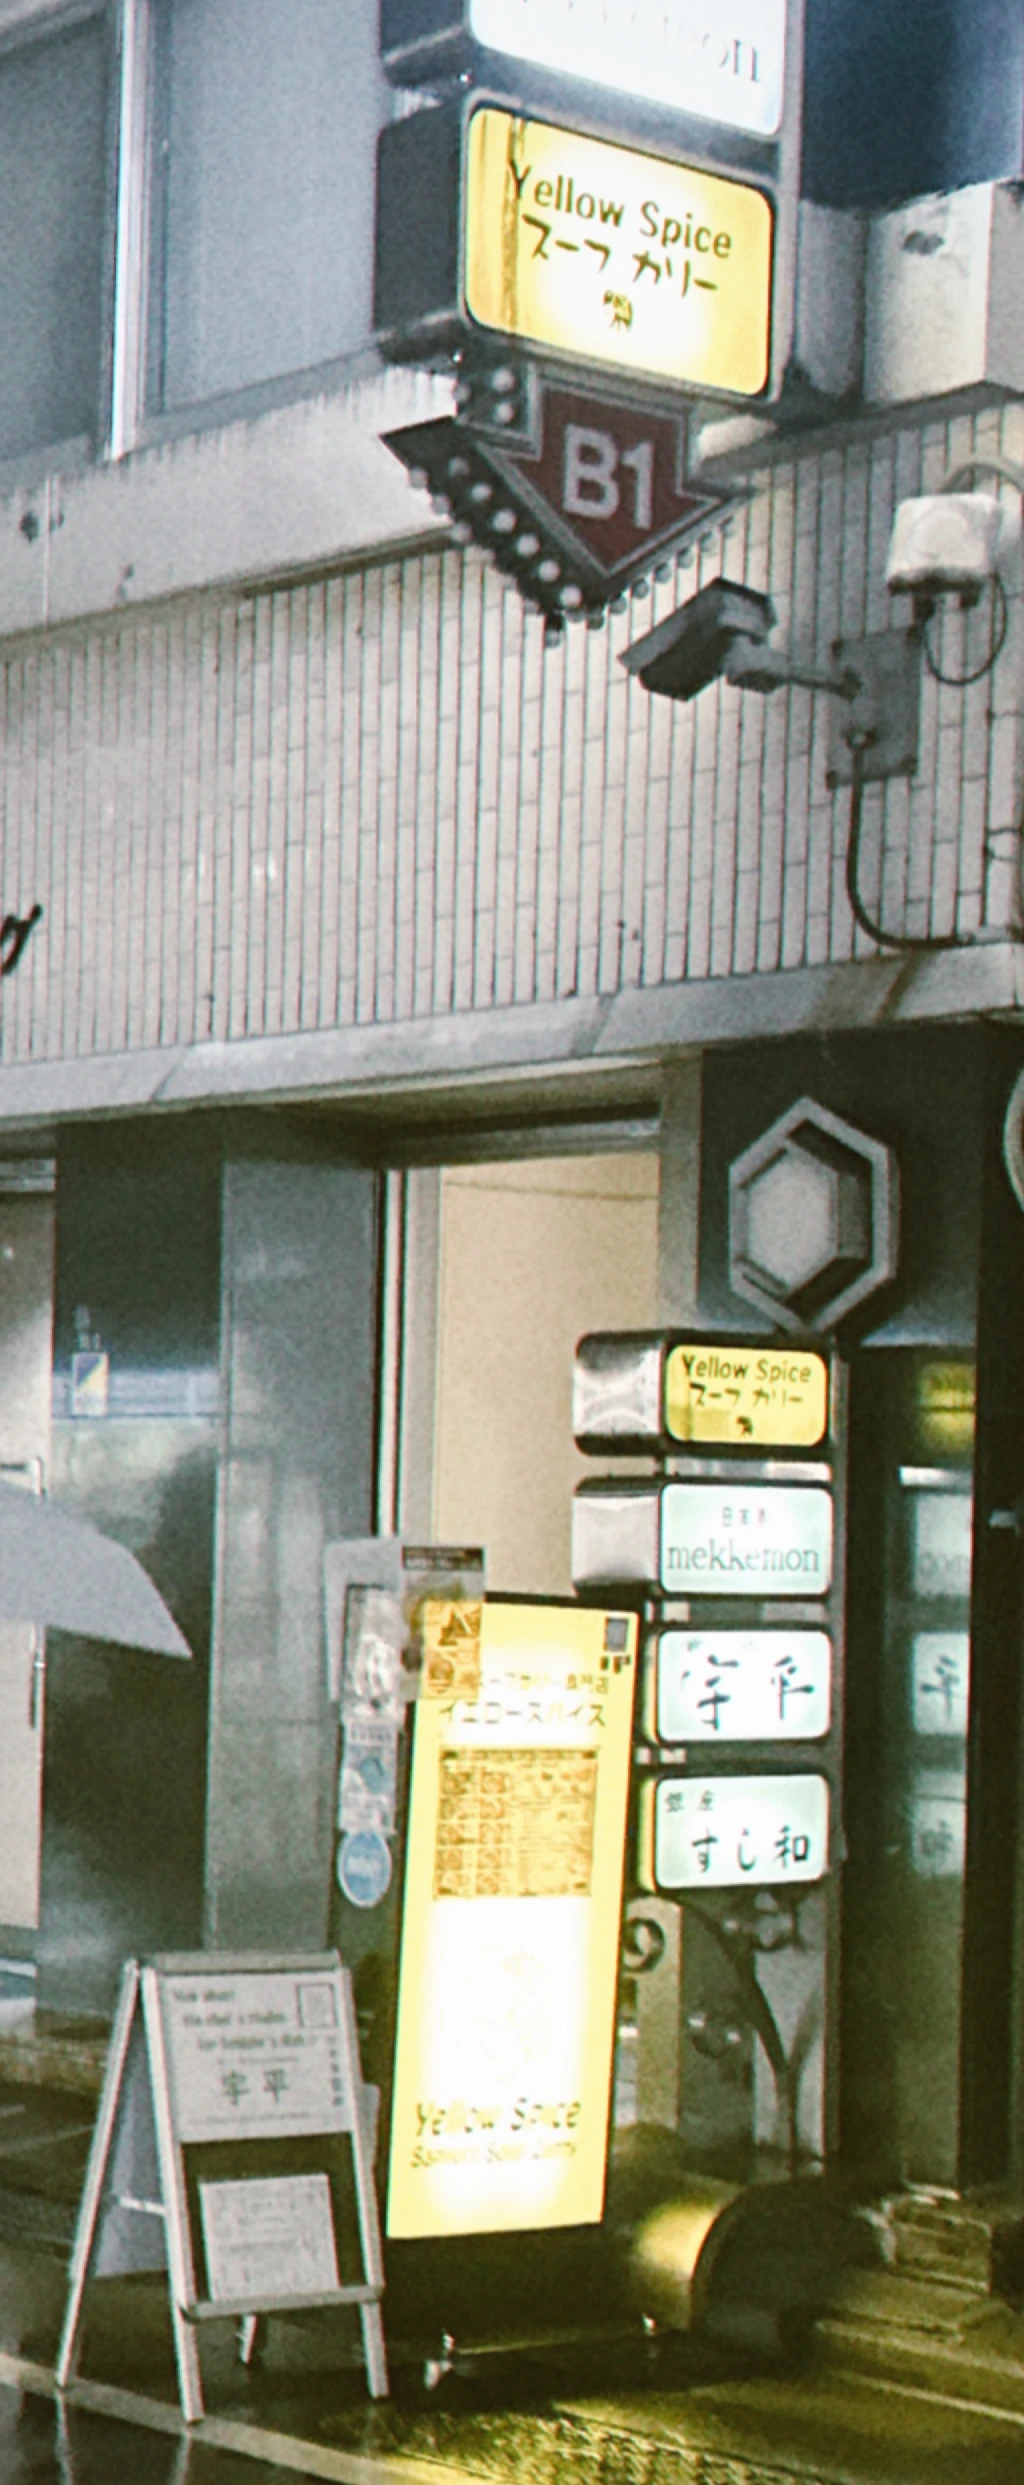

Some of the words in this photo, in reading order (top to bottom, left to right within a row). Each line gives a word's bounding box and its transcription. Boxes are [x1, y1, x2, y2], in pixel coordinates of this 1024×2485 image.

[508, 160, 625, 228] Yellow
[640, 201, 732, 259] Spice
[563, 423, 655, 530] B1
[681, 1353, 748, 1380] Yellow
[756, 1357, 812, 1383] Spice
[667, 1537, 821, 1573] mekkemon
[691, 1824, 811, 1874] すし和
[415, 2101, 499, 2136] Yeow
[511, 2096, 581, 2131] Spce
